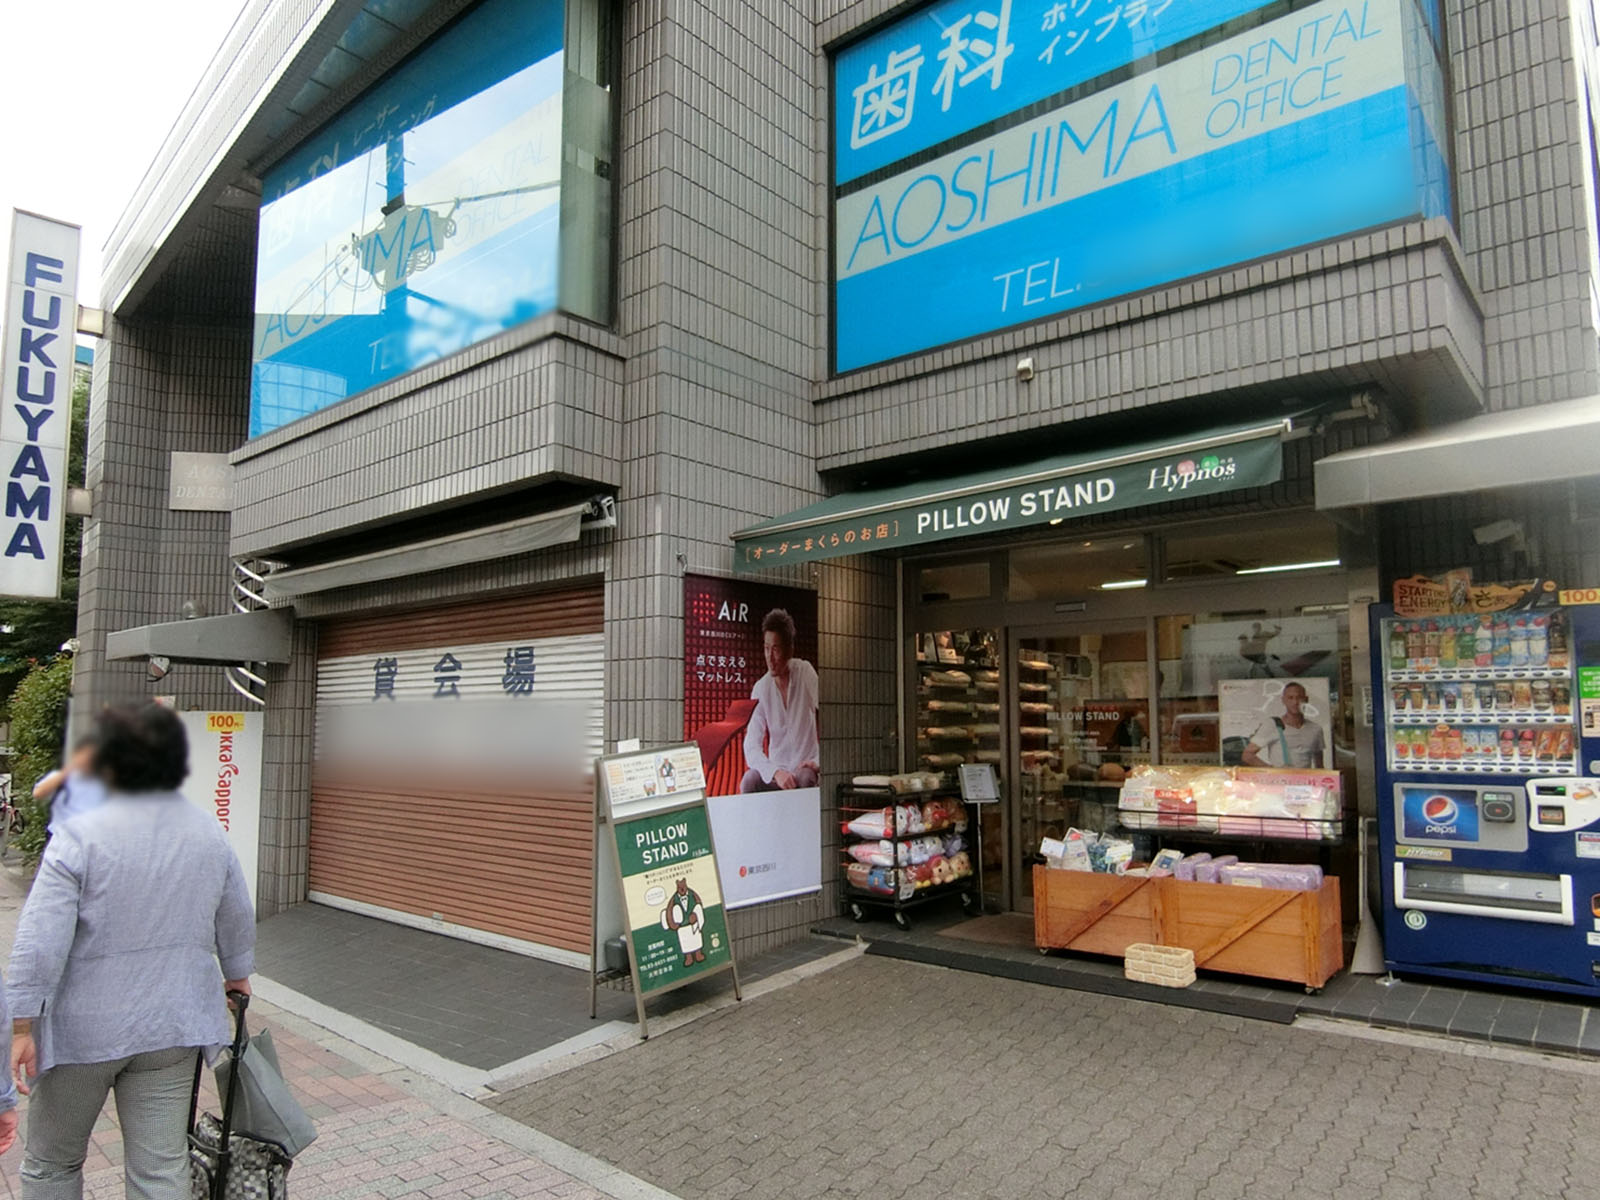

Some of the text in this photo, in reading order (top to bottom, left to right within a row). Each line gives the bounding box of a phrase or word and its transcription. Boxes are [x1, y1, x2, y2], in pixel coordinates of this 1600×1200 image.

[1211, 0, 1382, 97] DENTAL
[849, 2, 1015, 152] 歯科
[1206, 55, 1345, 139] OFFICE
[846, 83, 1177, 271] AOSHIMA
[993, 258, 1082, 313] TEL.
[4, 252, 64, 560] FUKUYAMA
[1147, 463, 1236, 492] Hypnos
[917, 478, 1116, 535] PILLOW STAND
[373, 646, 536, 701] 貸会場
[696, 654, 746, 668] 点で支える
[1086, 711, 1120, 721] STAND
[636, 822, 688, 848] PILLOW
[642, 841, 689, 865] STAND
[1425, 824, 1457, 835] pepsi
